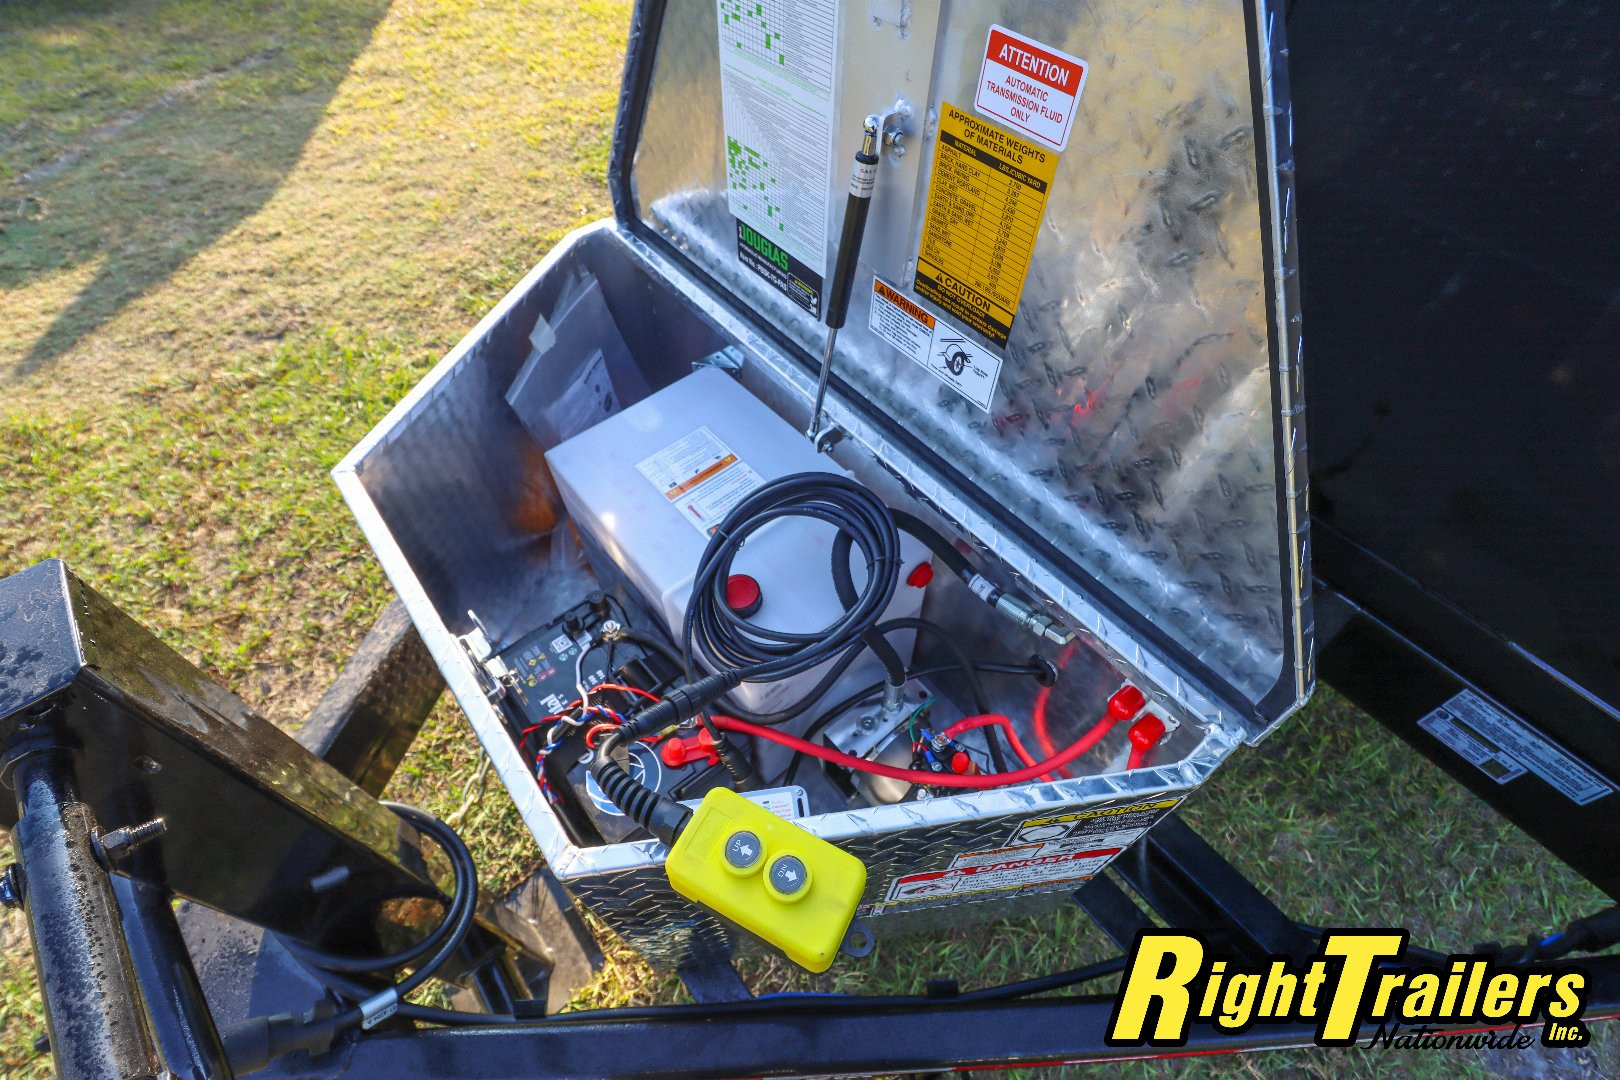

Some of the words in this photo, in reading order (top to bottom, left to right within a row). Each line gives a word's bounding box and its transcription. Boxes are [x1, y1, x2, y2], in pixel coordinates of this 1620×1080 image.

[999, 43, 1070, 86] ATTENTION
[987, 81, 1040, 113] TRANSMISSION
[1040, 106, 1063, 124] FLUID
[1005, 75, 1048, 102] AUTOMATIC
[1010, 107, 1030, 123] ONLY
[948, 110, 1005, 145] APPROXIMATE
[1006, 138, 1046, 163] WEIGHTS
[953, 139, 977, 157] MATERIAL
[963, 128, 975, 141] OF
[976, 134, 1023, 164] MATERIALS
[968, 167, 981, 178] CLAY
[887, 290, 929, 324] WARNING
[945, 279, 991, 313] CAUTION
[732, 839, 742, 852] UP
[975, 853, 1076, 874] DANGER
